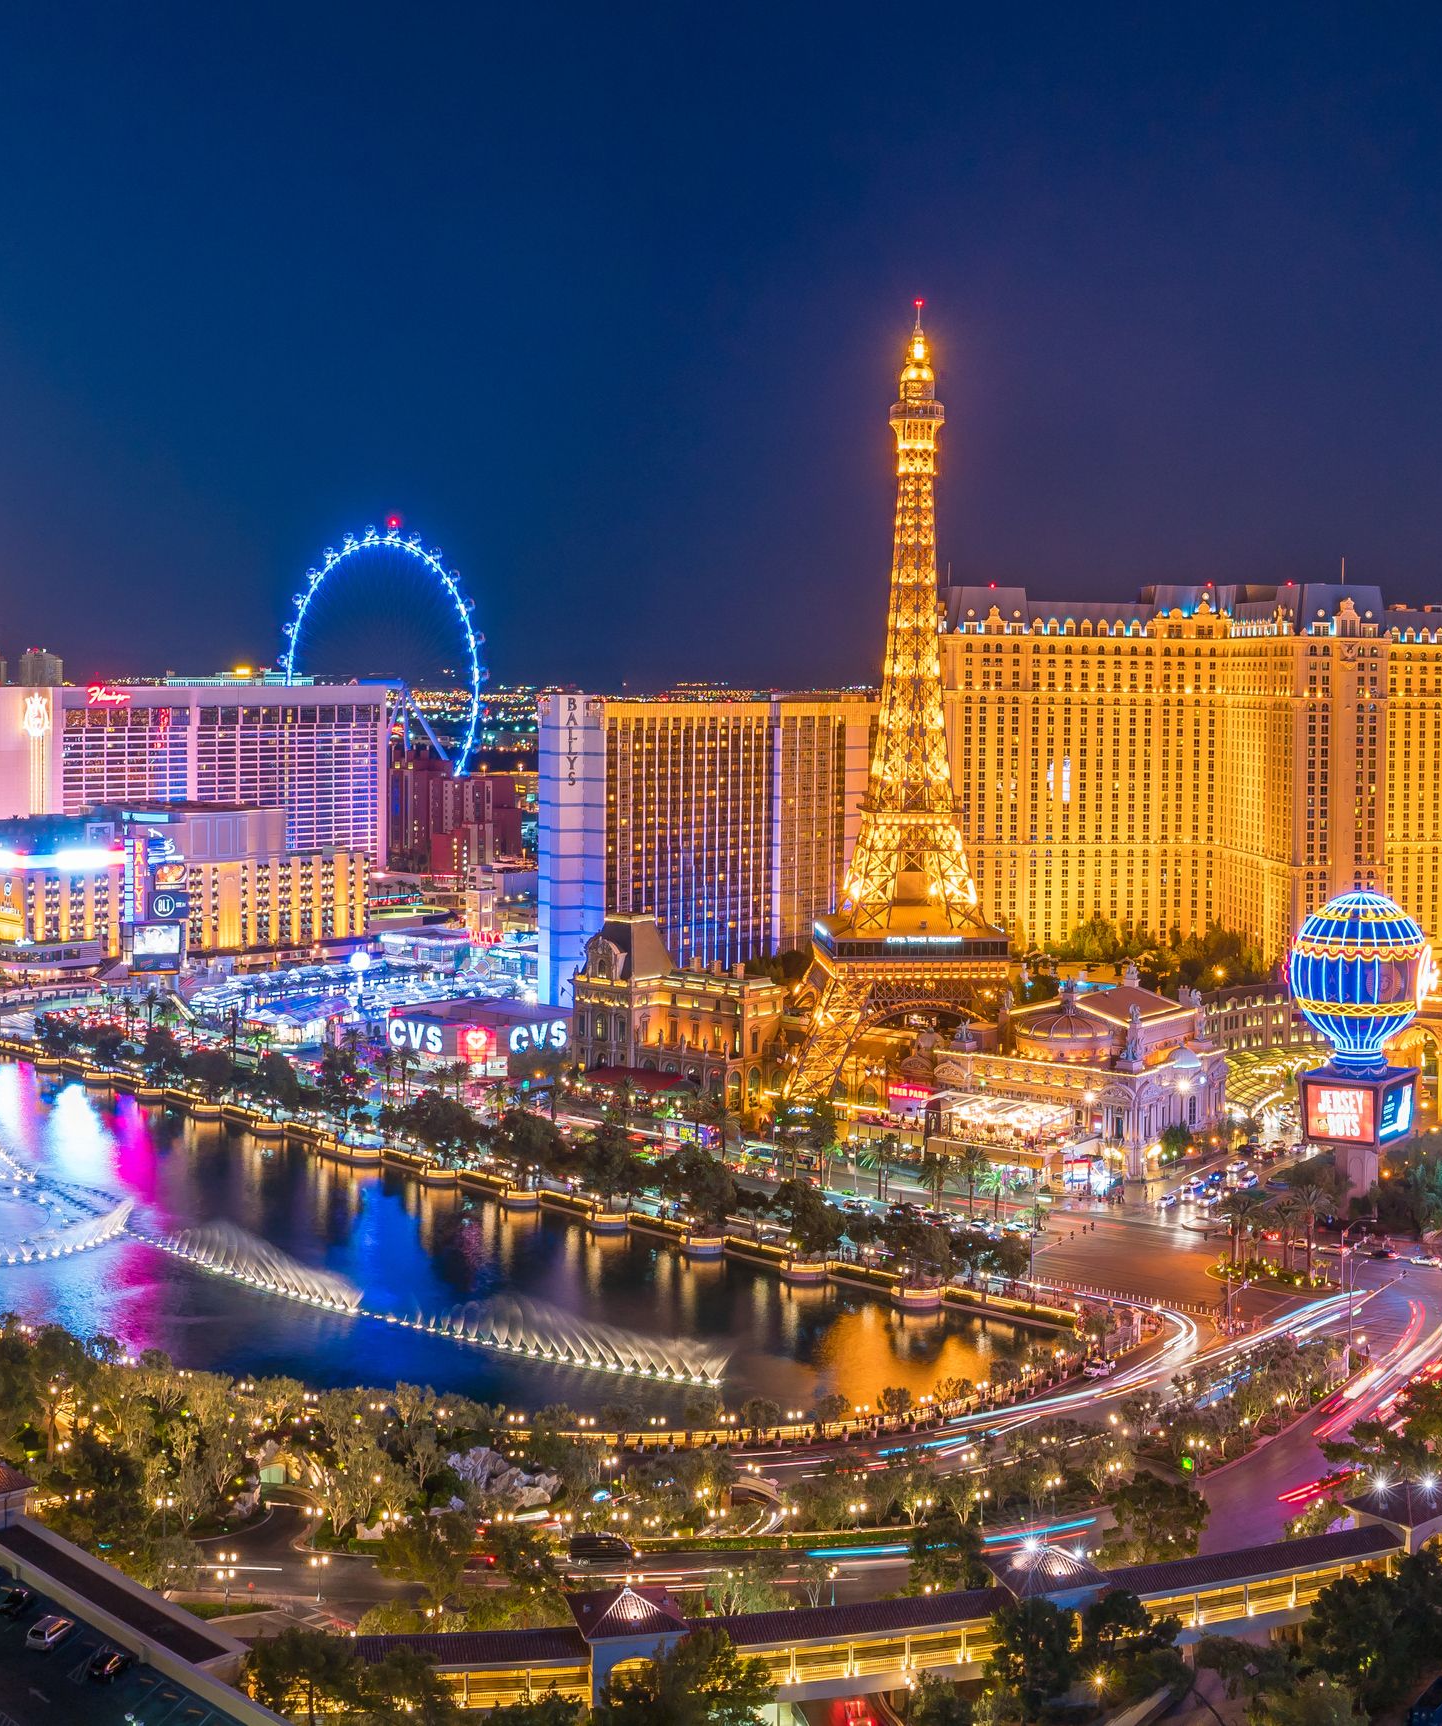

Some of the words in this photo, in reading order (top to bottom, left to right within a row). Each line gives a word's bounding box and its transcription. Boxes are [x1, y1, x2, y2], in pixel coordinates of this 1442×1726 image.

[565, 697, 578, 787] BALLYS
[157, 897, 171, 912] BLT
[389, 1018, 443, 1053] CVS
[509, 1020, 567, 1055] CVS
[888, 1086, 908, 1097] BEER
[908, 1089, 929, 1099] PARK
[1317, 1090, 1364, 1114] JERSEY
[1326, 1113, 1361, 1137] BOYS
